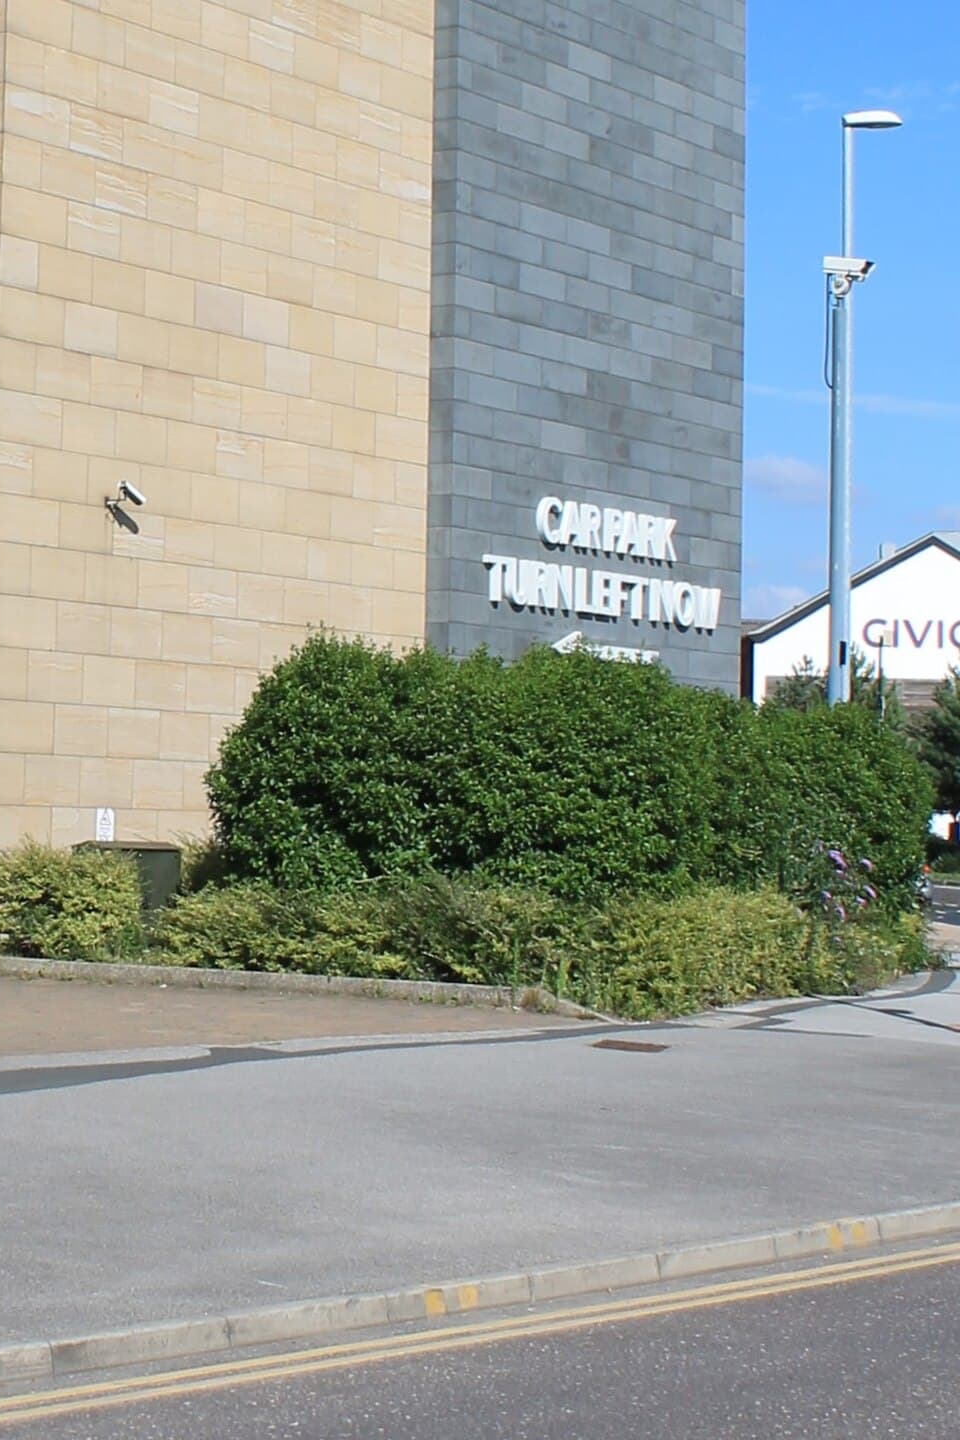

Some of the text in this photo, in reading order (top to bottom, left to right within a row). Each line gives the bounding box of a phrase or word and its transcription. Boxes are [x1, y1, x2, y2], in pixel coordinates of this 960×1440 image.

[535, 496, 678, 563] CAR PARK
[482, 554, 722, 631] TURN LEFT NOW
